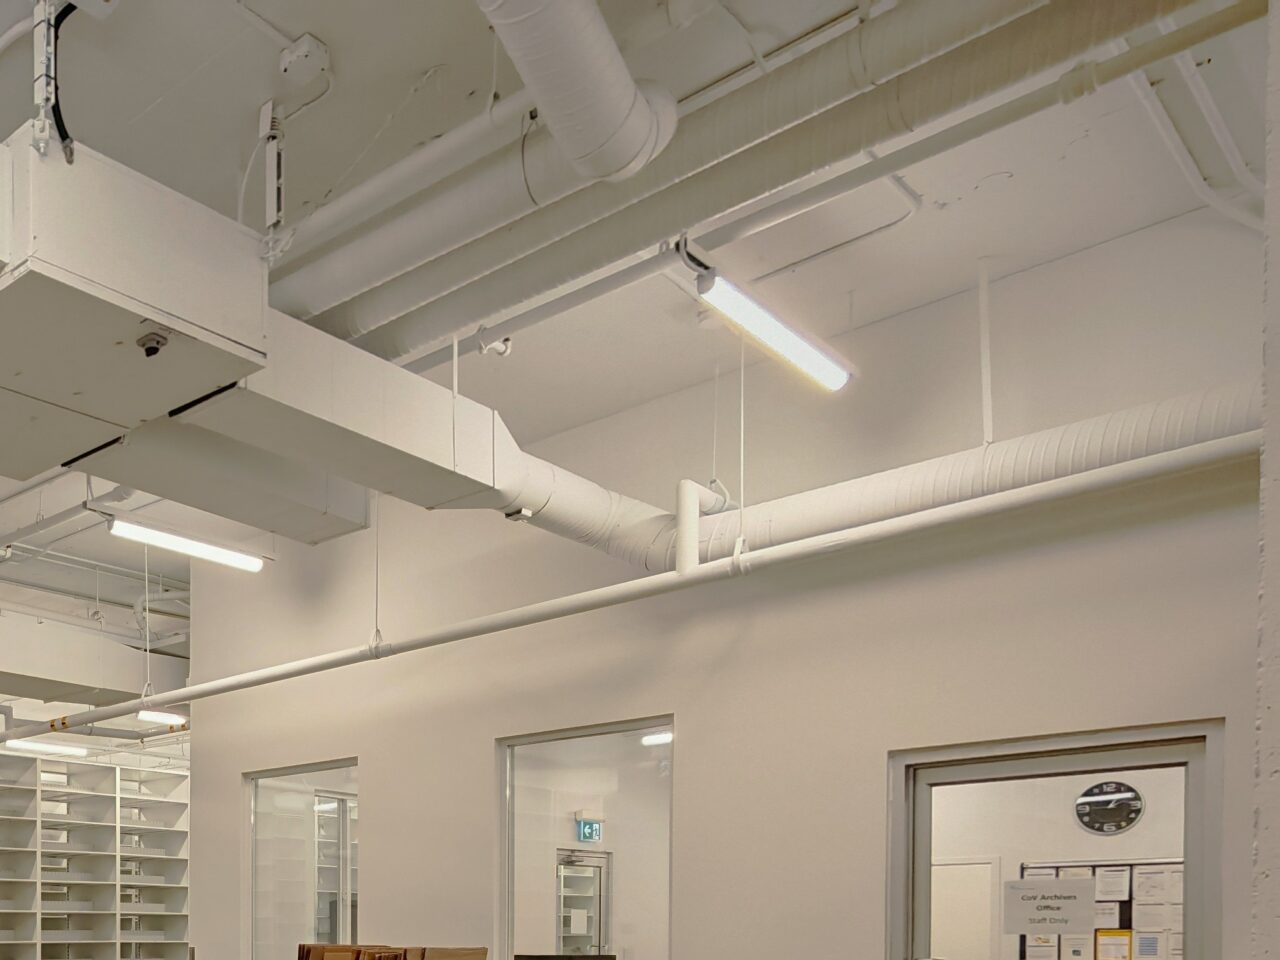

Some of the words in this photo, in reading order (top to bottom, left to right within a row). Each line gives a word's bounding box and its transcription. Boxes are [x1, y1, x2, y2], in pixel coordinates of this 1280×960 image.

[1103, 784, 1117, 792] 12
[1128, 800, 1142, 809] 3
[1077, 805, 1090, 813] 9
[1103, 823, 1117, 832] 6
[1049, 917, 1069, 925] Only
